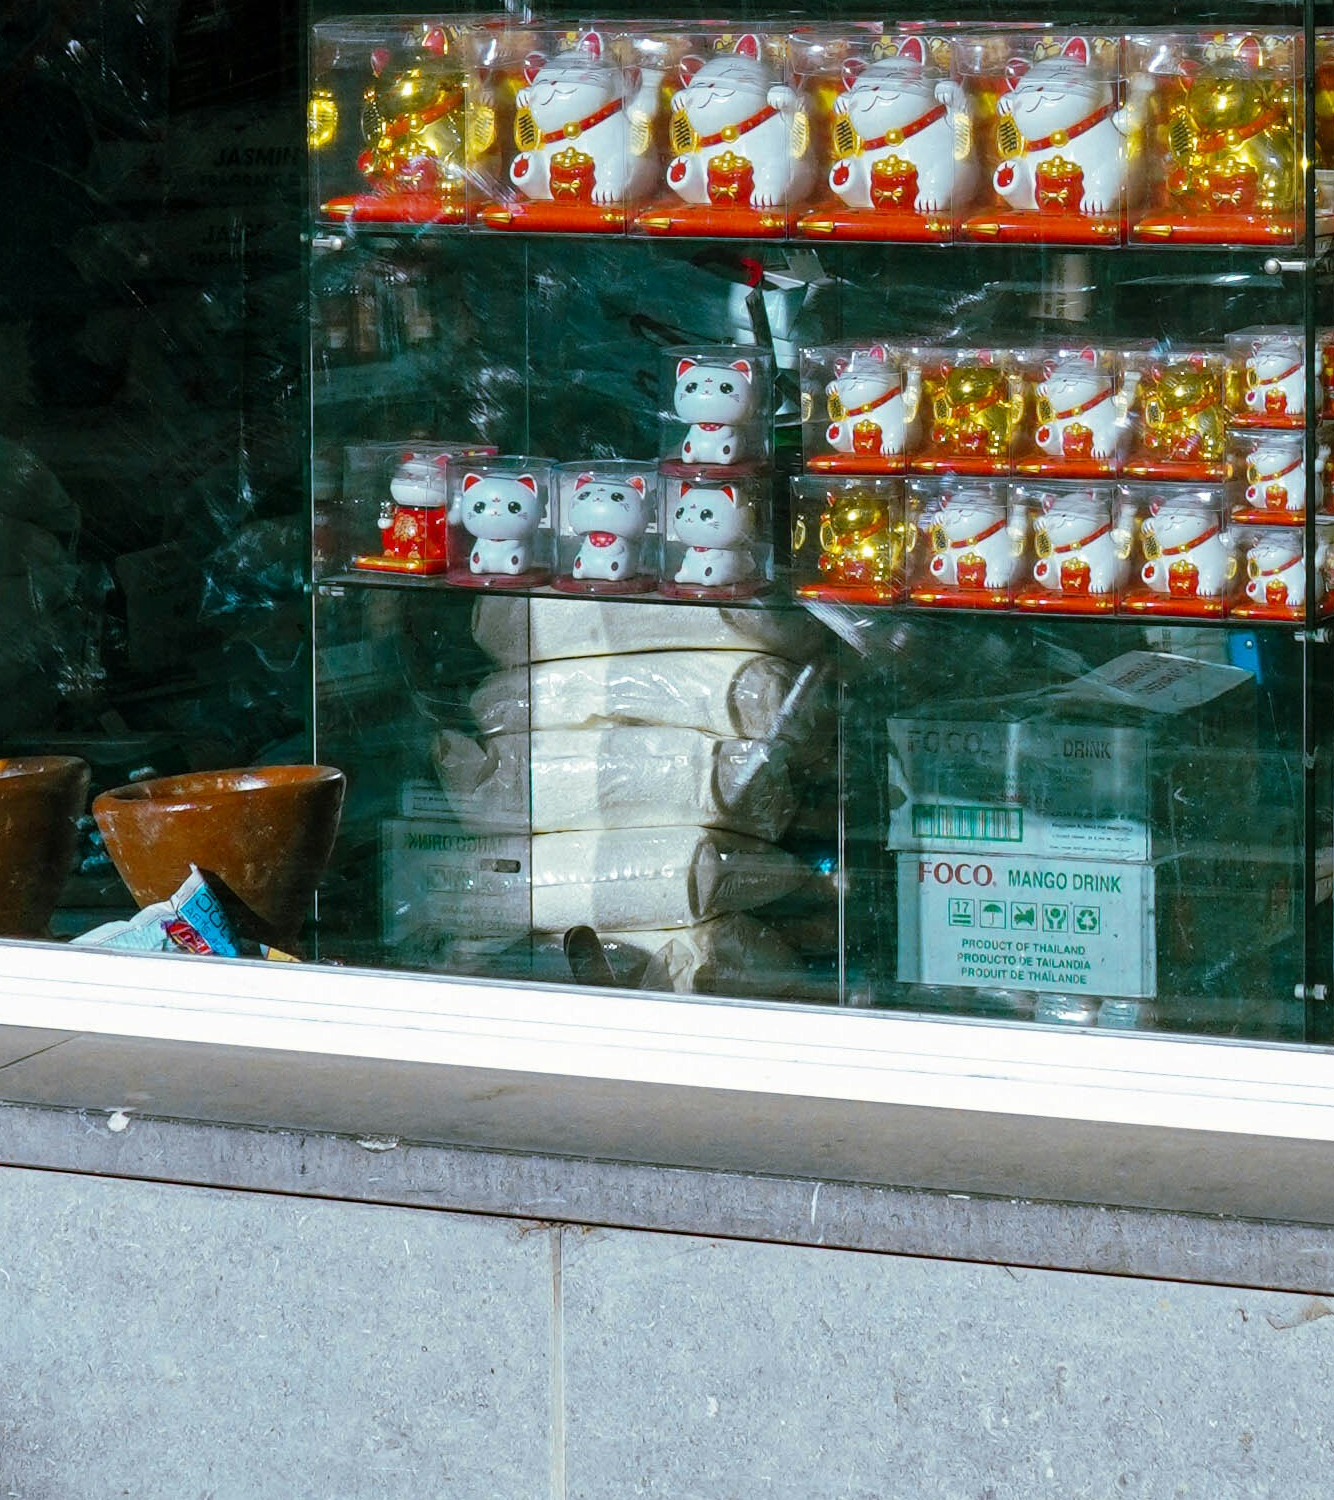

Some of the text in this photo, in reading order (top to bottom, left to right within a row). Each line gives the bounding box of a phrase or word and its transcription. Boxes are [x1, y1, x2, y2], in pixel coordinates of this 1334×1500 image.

[1062, 738, 1113, 760] DRINK
[918, 861, 1122, 894] FOCO MANGO DRINK
[961, 938, 1086, 956] PRODUCT OF THAILAND
[956, 953, 1091, 970] PRODUCTO DE TAILANDIA
[960, 967, 1088, 985] PRODUIT DE THAÏLANDE
